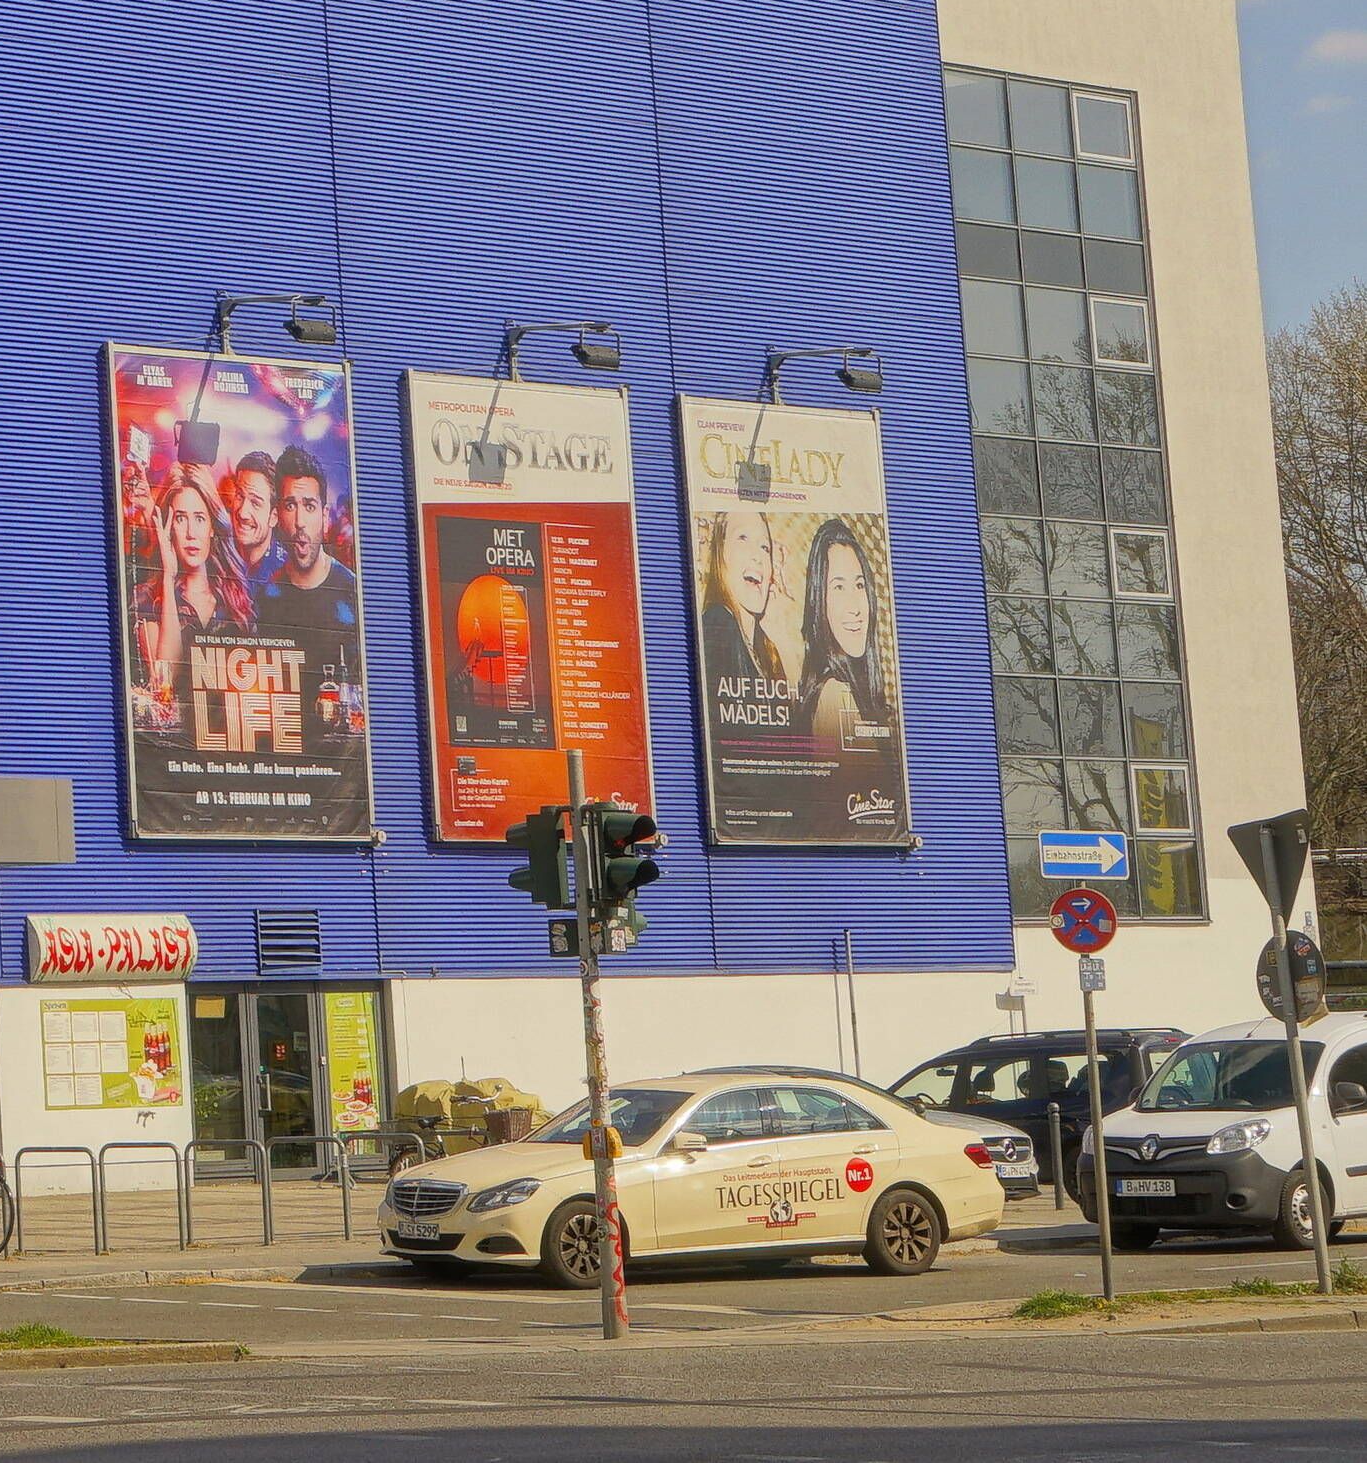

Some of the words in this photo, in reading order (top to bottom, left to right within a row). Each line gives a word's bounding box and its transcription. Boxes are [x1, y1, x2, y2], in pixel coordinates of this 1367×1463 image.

[428, 400, 487, 416] METROPOLITAN
[493, 527, 525, 547] MET
[485, 547, 535, 567] OPERA
[194, 635, 206, 644] EIN
[190, 646, 306, 693] NIGHT
[717, 676, 751, 698] AUF
[755, 678, 804, 704] EUCH,
[193, 690, 303, 753] LIFE
[719, 698, 790, 727] MÄDELS!
[168, 760, 181, 772] Ein
[182, 761, 204, 773] Date.
[195, 790, 210, 805] AB
[212, 791, 228, 805] 13.
[229, 791, 271, 806] FEBRUAR
[272, 792, 286, 806] IM
[287, 792, 312, 806] KINO
[846, 788, 895, 815] CineStar
[723, 1173, 737, 1182] Das
[737, 1171, 780, 1182] Leitmedium
[780, 1169, 792, 1178] der
[847, 1169, 872, 1182] Nr.1
[715, 1178, 845, 1209] TAGESSPIEGEL
[1153, 1181, 1171, 1192] 138
[416, 1225, 438, 1238] 5299
